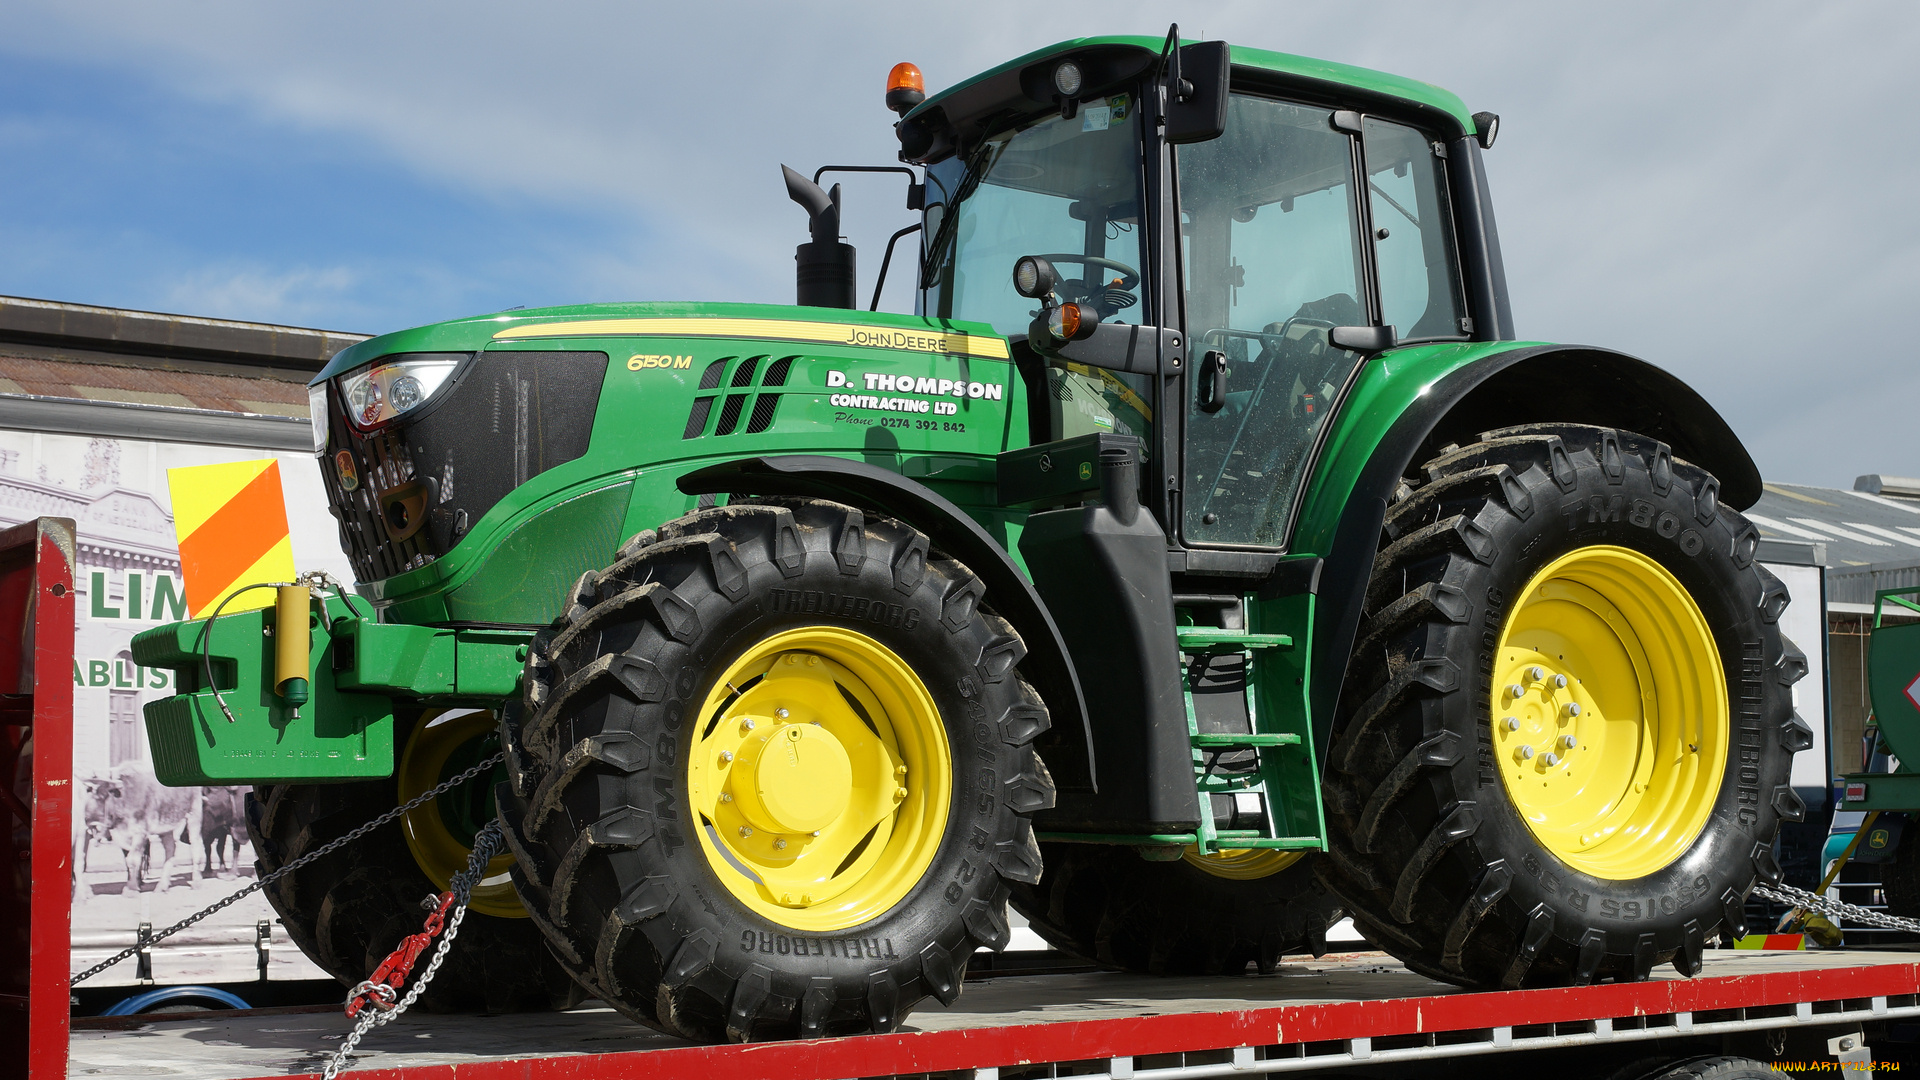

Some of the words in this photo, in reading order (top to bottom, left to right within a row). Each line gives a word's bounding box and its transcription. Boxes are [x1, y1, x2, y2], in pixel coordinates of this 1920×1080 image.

[847, 328, 890, 345] JOHN
[894, 332, 948, 351] DEERE
[825, 370, 854, 388] D.
[863, 372, 1003, 401] THOMPSON
[829, 393, 930, 414] CONTRACTING
[933, 401, 958, 416] LTD
[834, 411, 874, 426] Phone
[880, 416, 911, 429] 0274
[915, 419, 938, 431] 392
[943, 421, 966, 433] 842
[1560, 494, 1705, 558] TM800
[769, 587, 921, 632] TRELLEBORG
[1477, 586, 1504, 789] TRELLEBORG
[1737, 636, 1765, 828] TRELLEBORG
[653, 665, 697, 858] TM800
[740, 929, 900, 961] TRELLEBORG
